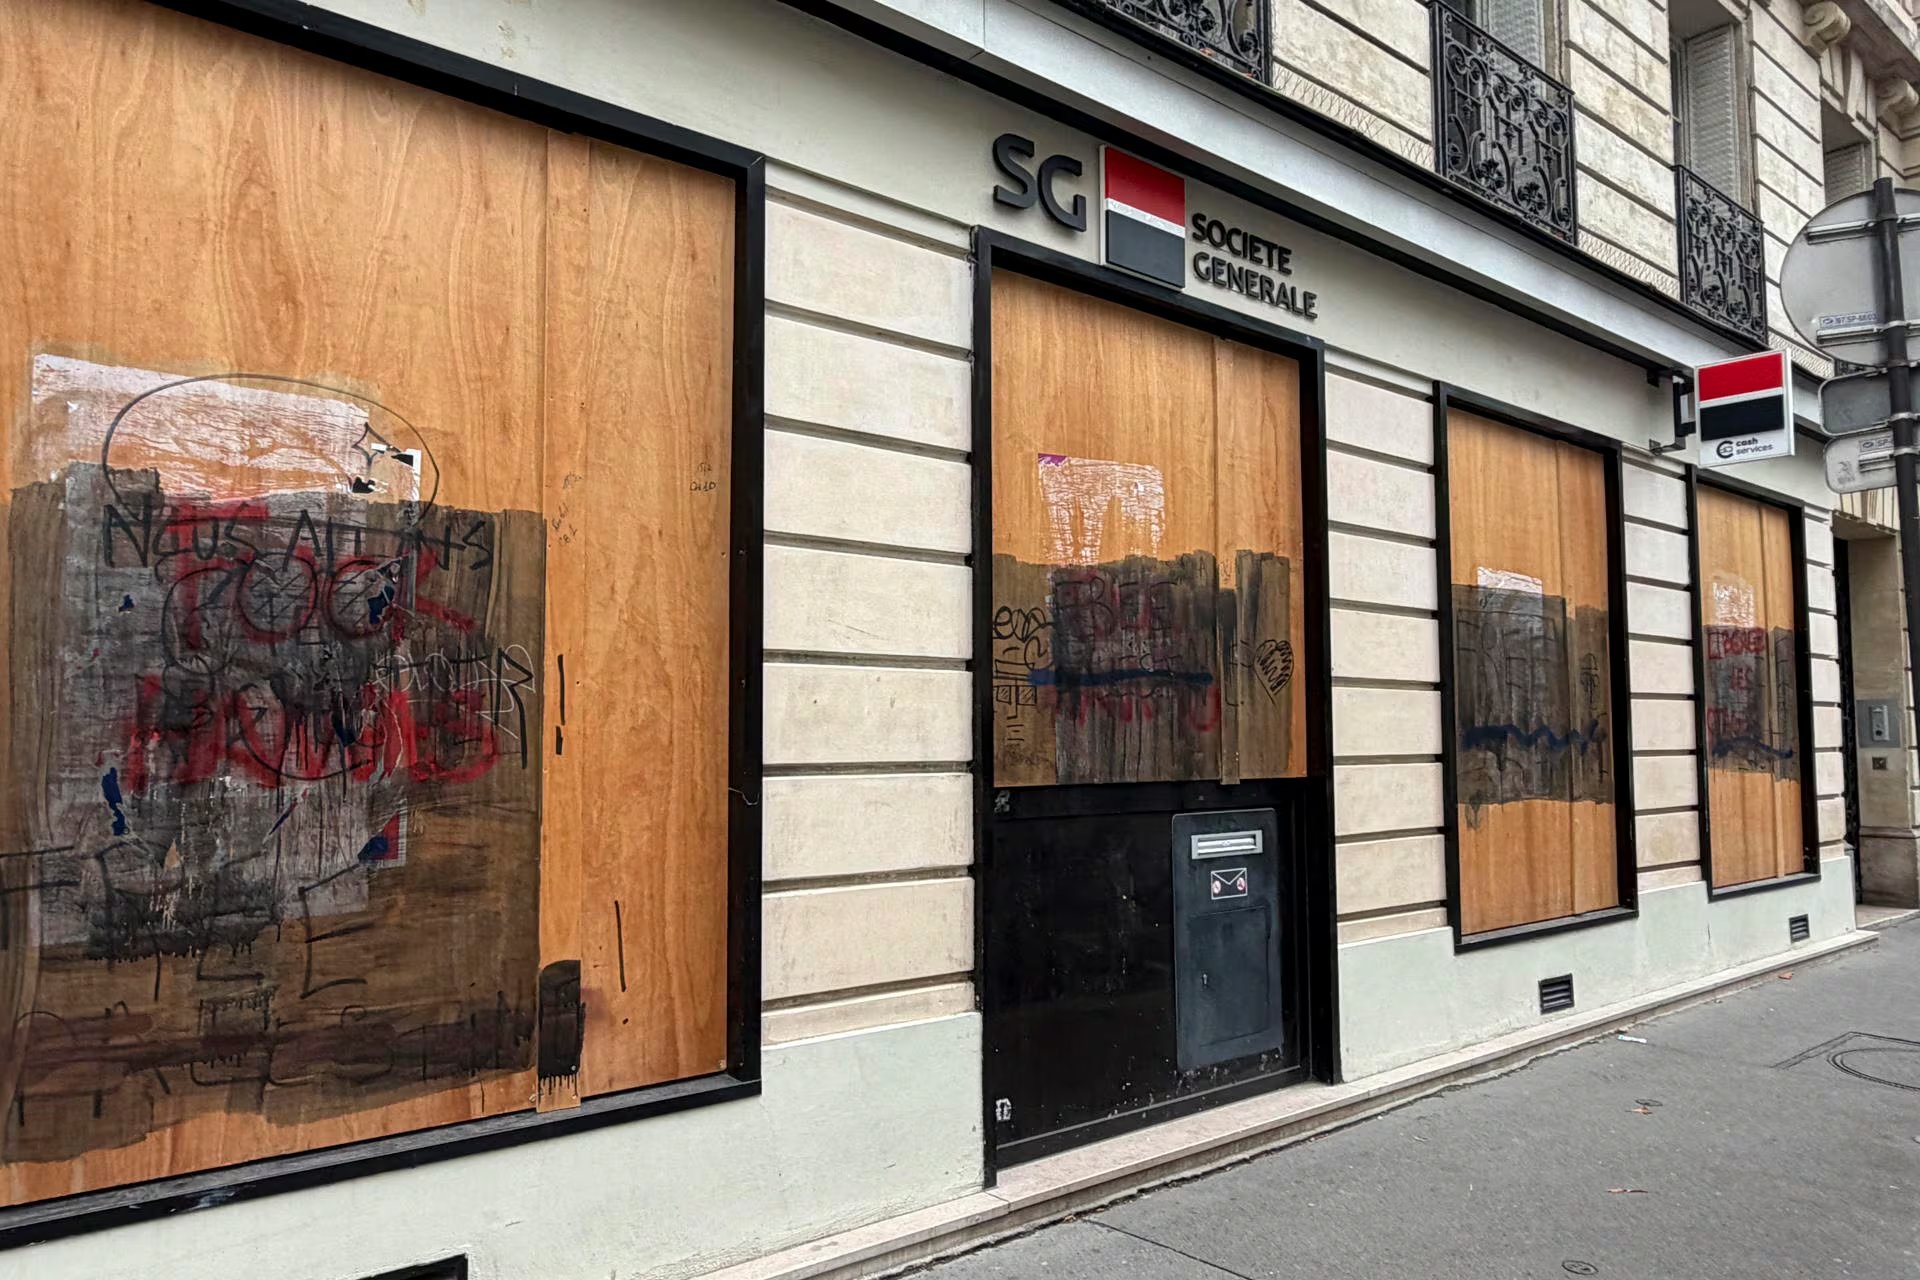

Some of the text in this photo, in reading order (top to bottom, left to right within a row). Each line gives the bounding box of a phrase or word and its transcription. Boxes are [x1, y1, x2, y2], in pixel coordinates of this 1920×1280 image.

[993, 133, 1087, 232] SG
[1192, 213, 1292, 275] SOCIETE
[1193, 252, 1318, 319] GENERALE
[1735, 437, 1759, 447] cash
[1735, 443, 1774, 455] services
